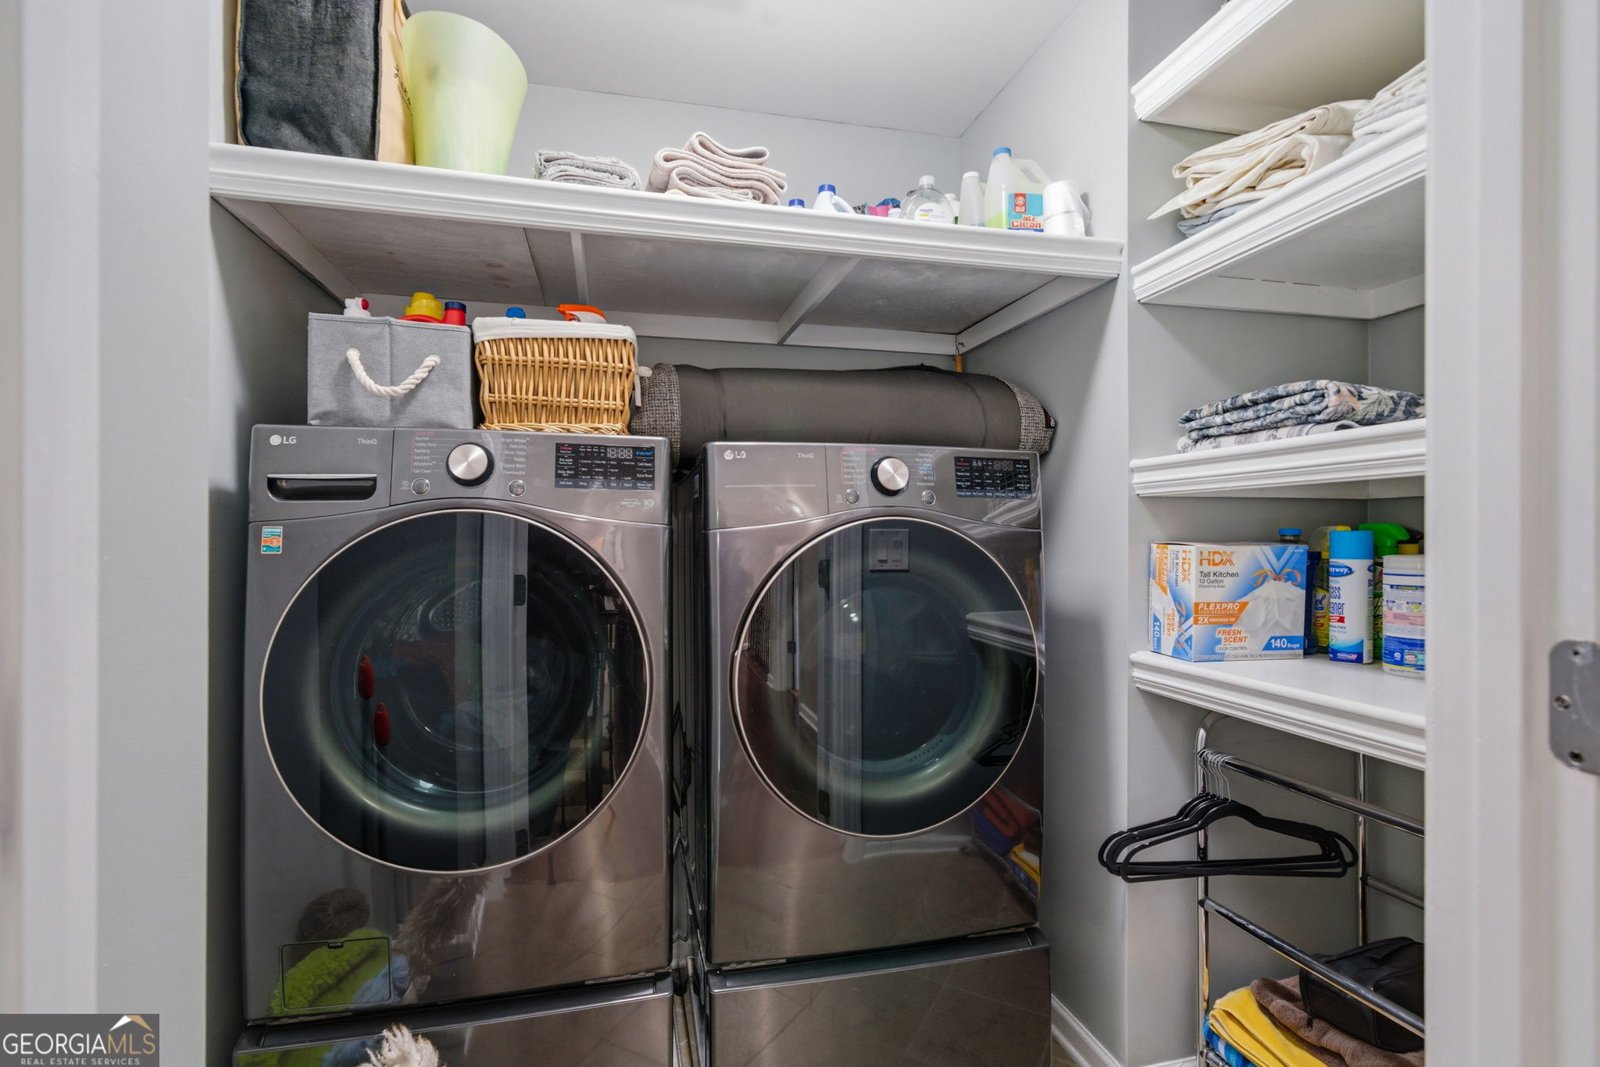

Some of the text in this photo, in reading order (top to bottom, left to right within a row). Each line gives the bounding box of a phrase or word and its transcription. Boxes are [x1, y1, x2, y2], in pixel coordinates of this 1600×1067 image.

[1011, 219, 1042, 229] Clean
[283, 436, 297, 444] LG
[735, 450, 747, 459] LG
[1199, 550, 1235, 567] HDX
[1198, 602, 1240, 610] FLEXPRO
[1198, 616, 1209, 624] 2X
[1270, 638, 1287, 648] 140
